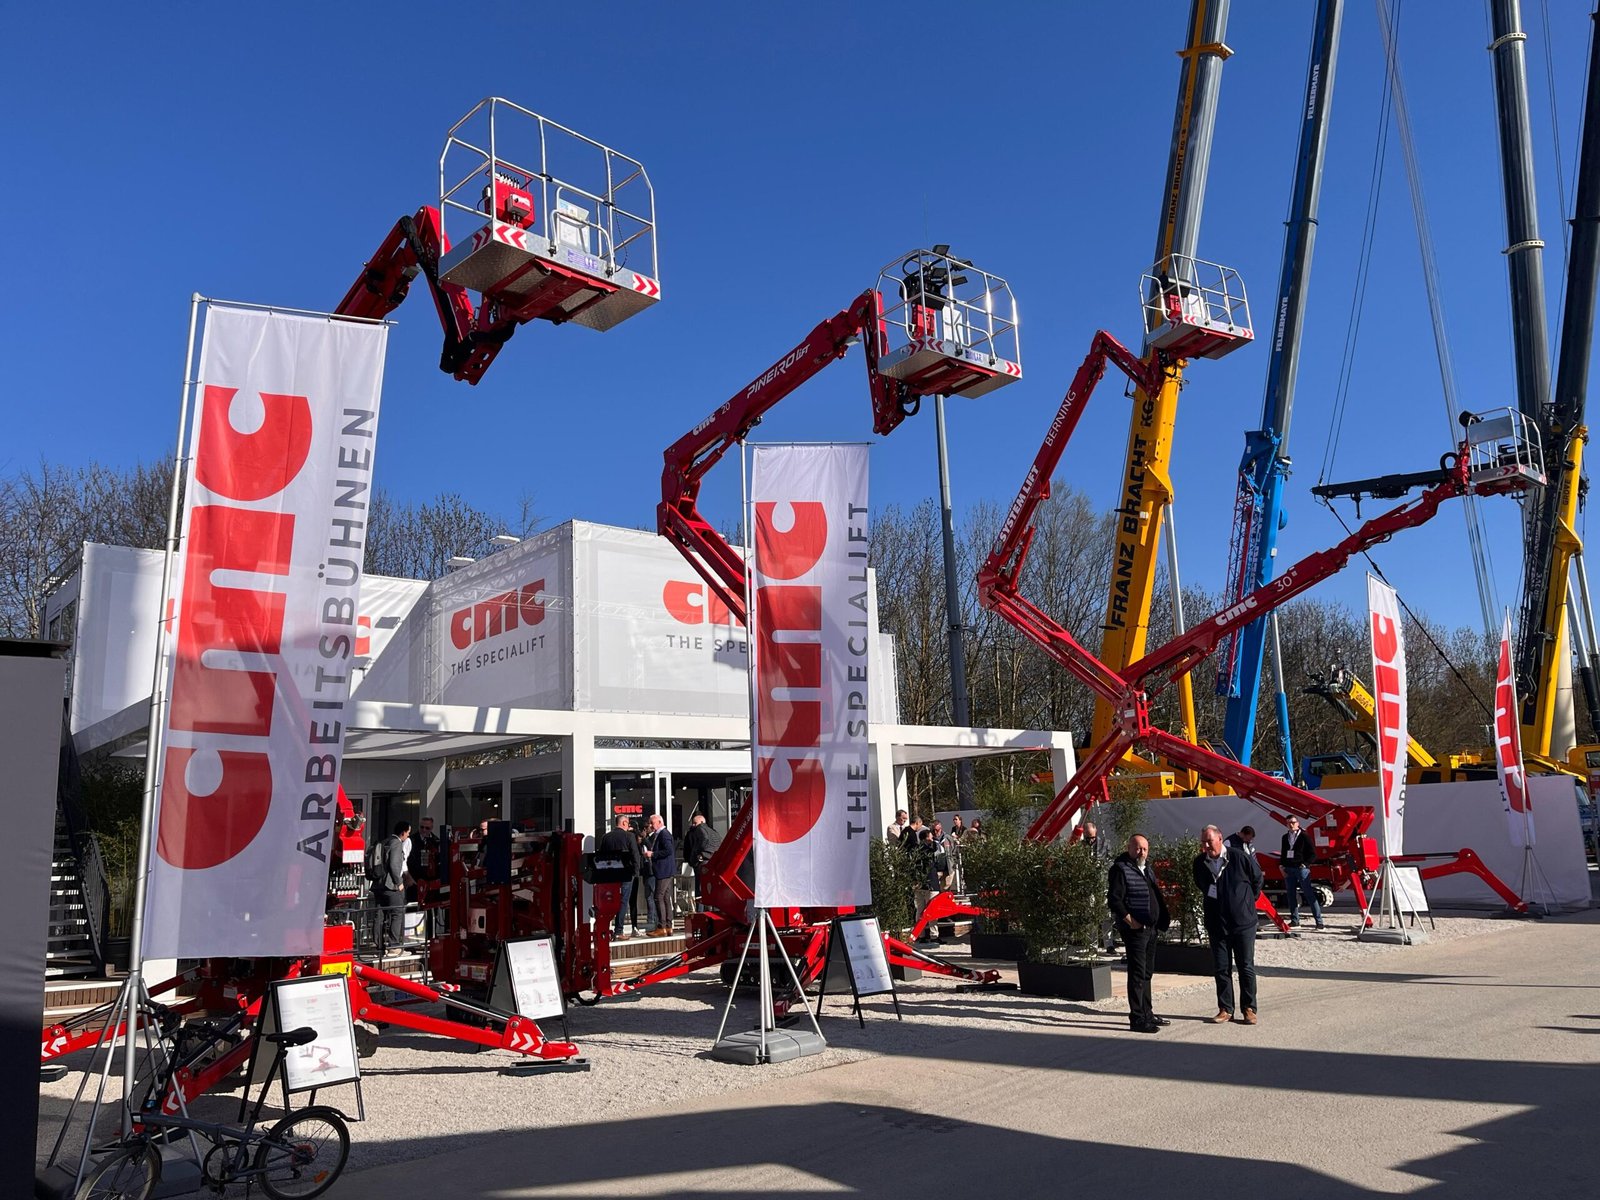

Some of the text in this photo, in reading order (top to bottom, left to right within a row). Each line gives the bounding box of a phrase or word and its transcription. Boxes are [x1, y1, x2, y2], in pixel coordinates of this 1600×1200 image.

[1306, 63, 1321, 121] FELBERMAYR
[1173, 153, 1185, 191] BRACHT
[1168, 192, 1179, 225] FRANZ
[1275, 296, 1289, 353] FELBERMAYR
[692, 401, 731, 437] cmc 20
[1044, 389, 1077, 448] BERNING
[999, 464, 1040, 543] SYSTEM LIFT
[1111, 398, 1155, 628] FRANZ BRACHT KG
[1562, 478, 1571, 507] GROVE
[157, 384, 313, 870] cmc
[451, 578, 546, 650] cmc
[1215, 574, 1293, 627] cmc 30
[296, 407, 376, 864] ARBEITSBÜHNEN
[451, 634, 546, 676] THE SPECIALIFT
[666, 634, 703, 651] THE
[755, 501, 828, 844] cmc
[847, 502, 869, 840] THE SPECIALIFT
[614, 804, 643, 814] cmc
